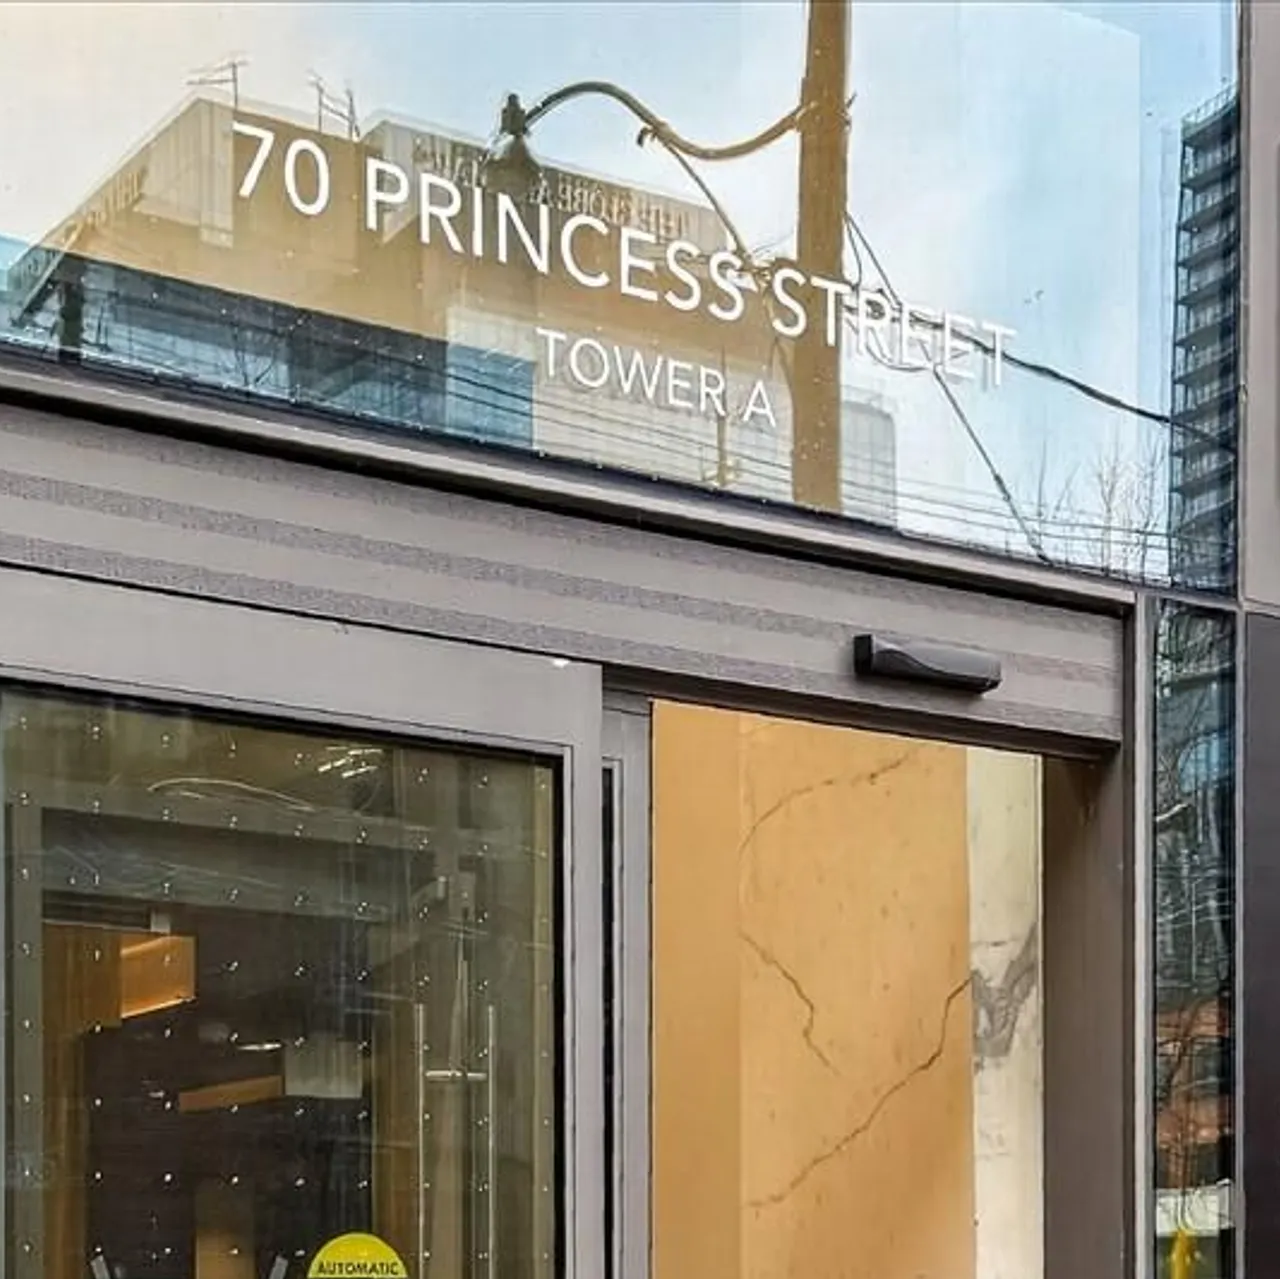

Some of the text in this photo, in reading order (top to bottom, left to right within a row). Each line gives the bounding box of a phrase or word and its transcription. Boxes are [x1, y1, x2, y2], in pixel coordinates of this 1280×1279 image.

[232, 121, 1017, 387] 70 PRINCESS STREET
[535, 326, 777, 429] TOWER A
[317, 1261, 400, 1276] AUTOMATIC
